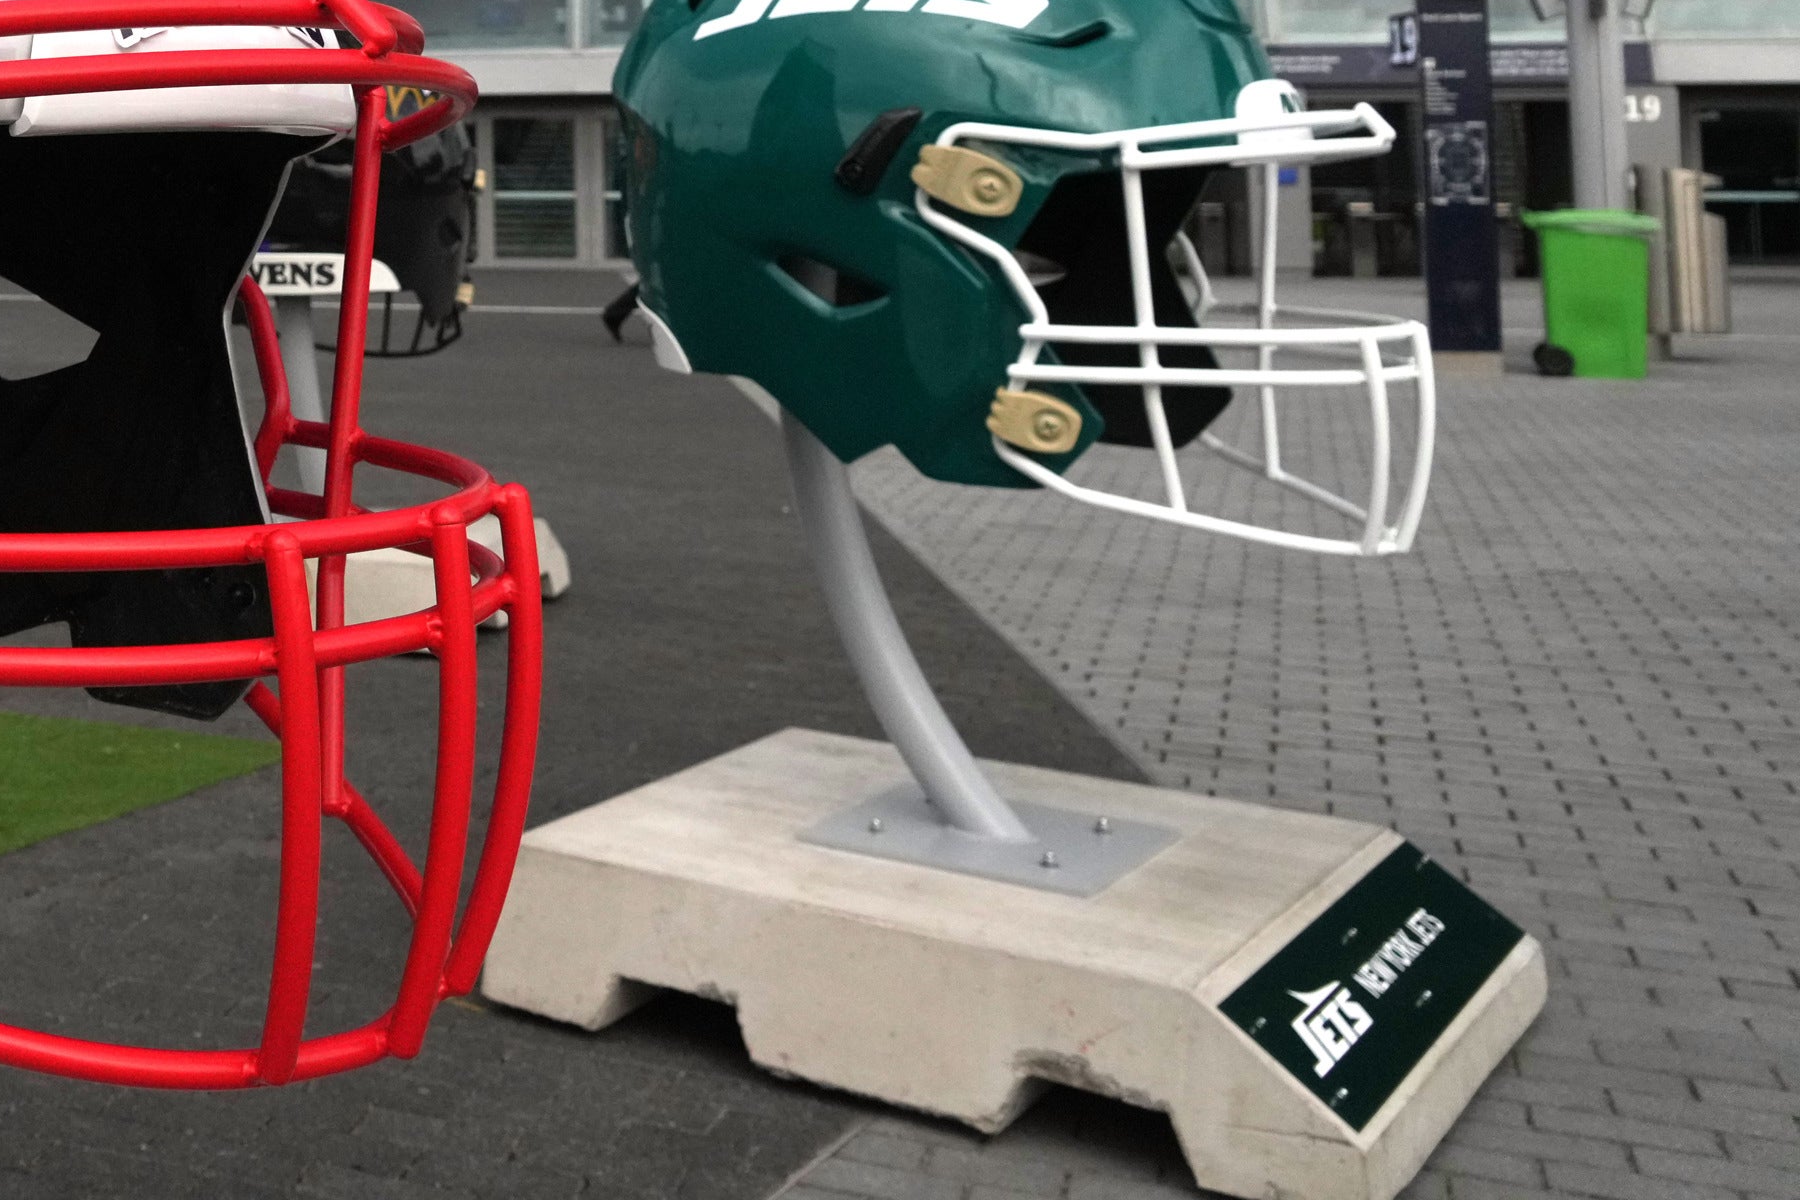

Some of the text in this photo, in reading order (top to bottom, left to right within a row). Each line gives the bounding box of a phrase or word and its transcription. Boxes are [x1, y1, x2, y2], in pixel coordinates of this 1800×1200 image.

[1391, 17, 1417, 64] 19
[1626, 94, 1661, 122] 19
[249, 262, 335, 287] VENS
[1352, 907, 1445, 999] NEW YORK JETS
[1285, 980, 1374, 1078] JETS
